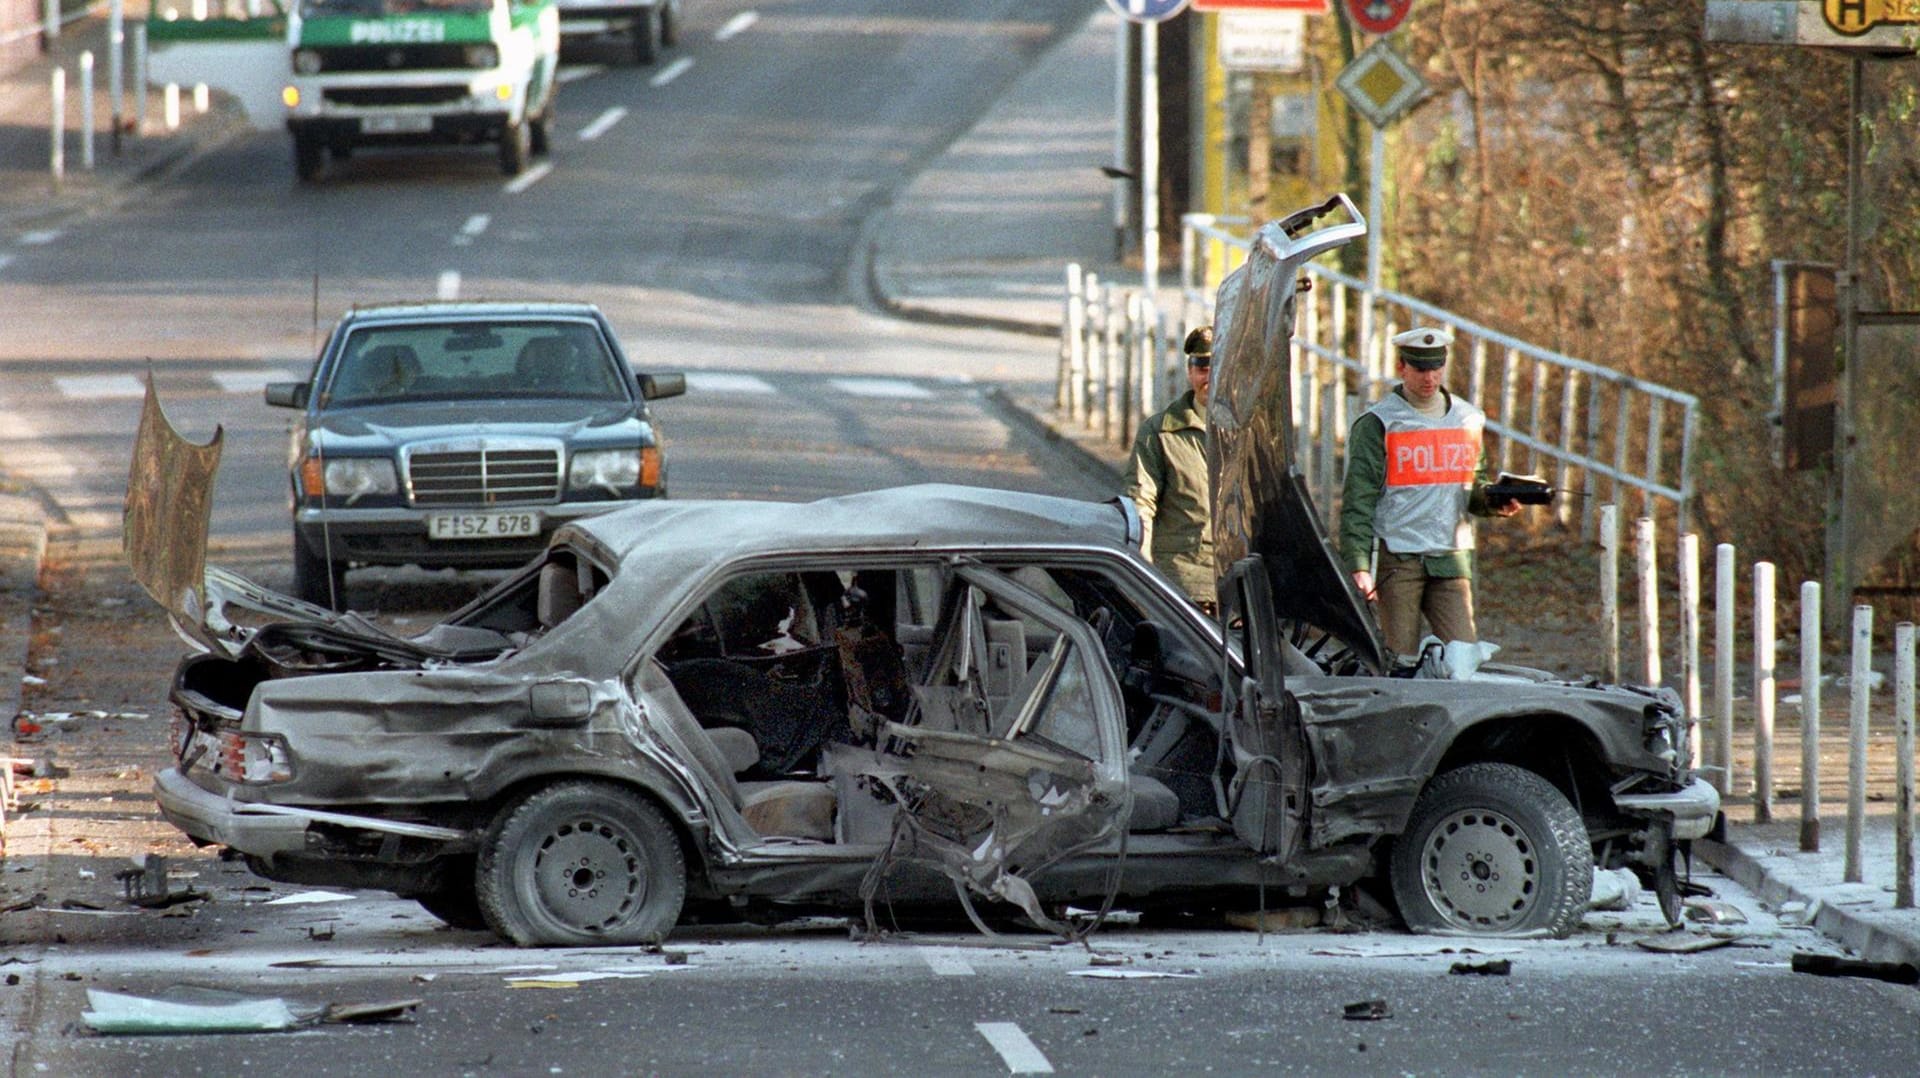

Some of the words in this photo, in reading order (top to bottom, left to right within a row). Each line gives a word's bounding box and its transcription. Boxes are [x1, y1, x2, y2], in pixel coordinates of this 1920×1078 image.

[1838, 0, 1865, 25] H
[351, 20, 445, 43] POLIZEI
[436, 516, 448, 533] F
[461, 515, 489, 533] SZ
[497, 513, 531, 532] 678
